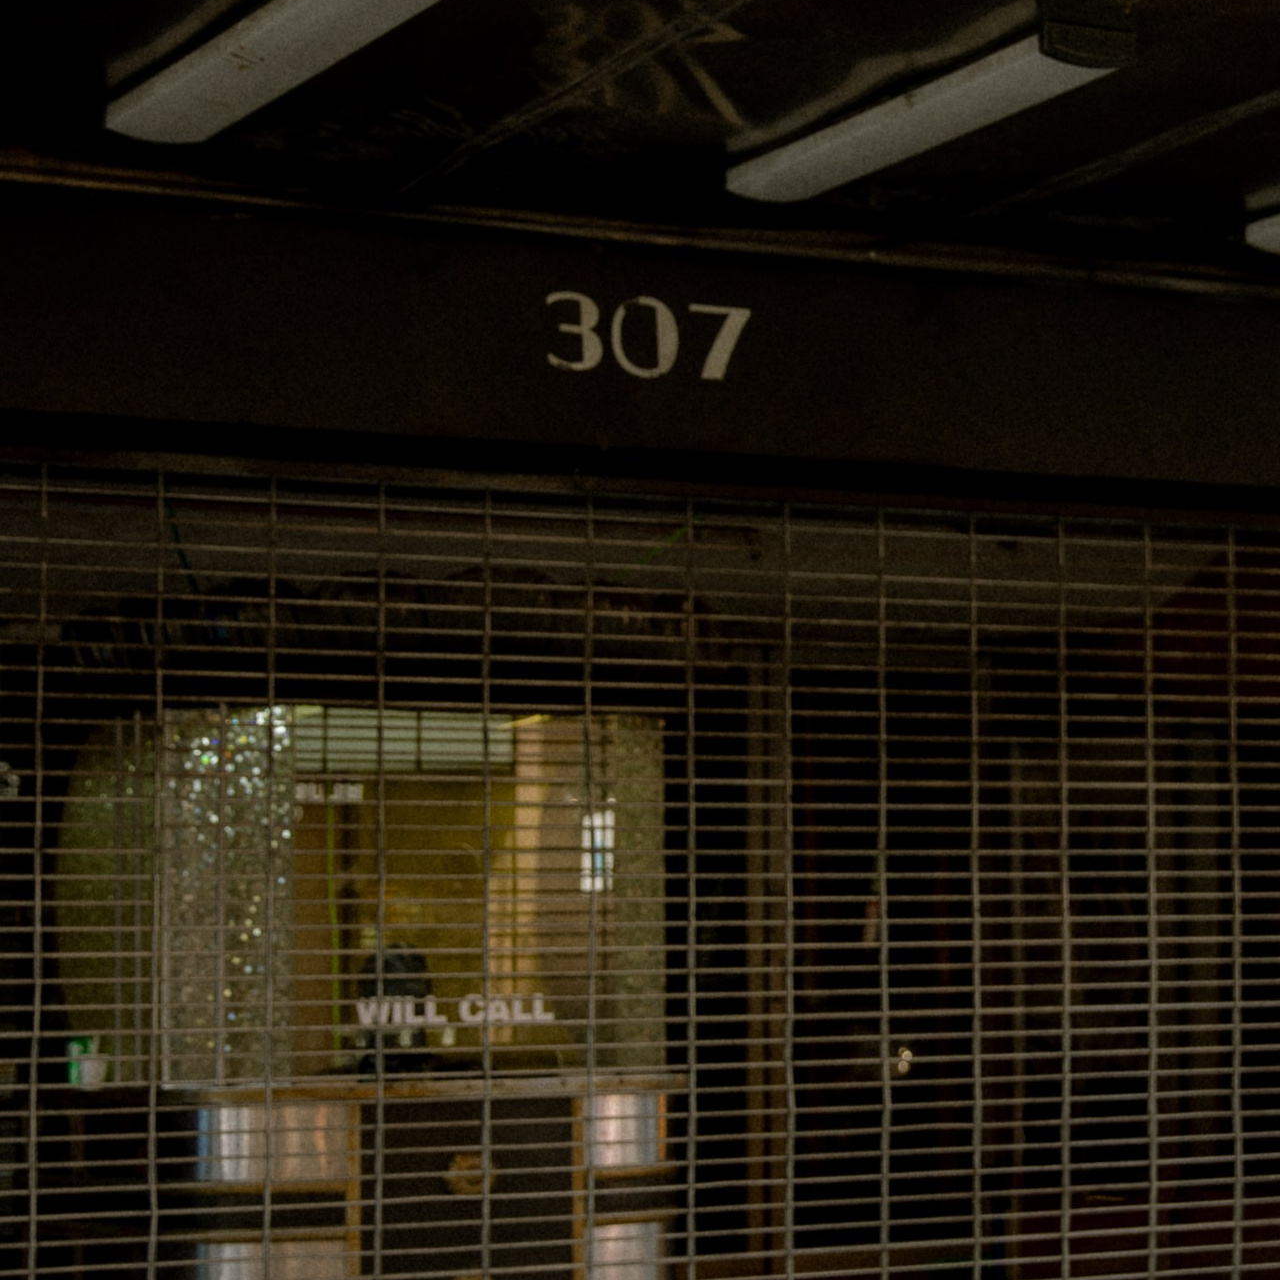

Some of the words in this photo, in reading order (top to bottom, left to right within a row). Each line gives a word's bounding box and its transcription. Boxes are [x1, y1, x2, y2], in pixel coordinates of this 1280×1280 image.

[546, 290, 751, 381] 307
[356, 995, 449, 1025] WILL
[458, 992, 556, 1023] CALL
